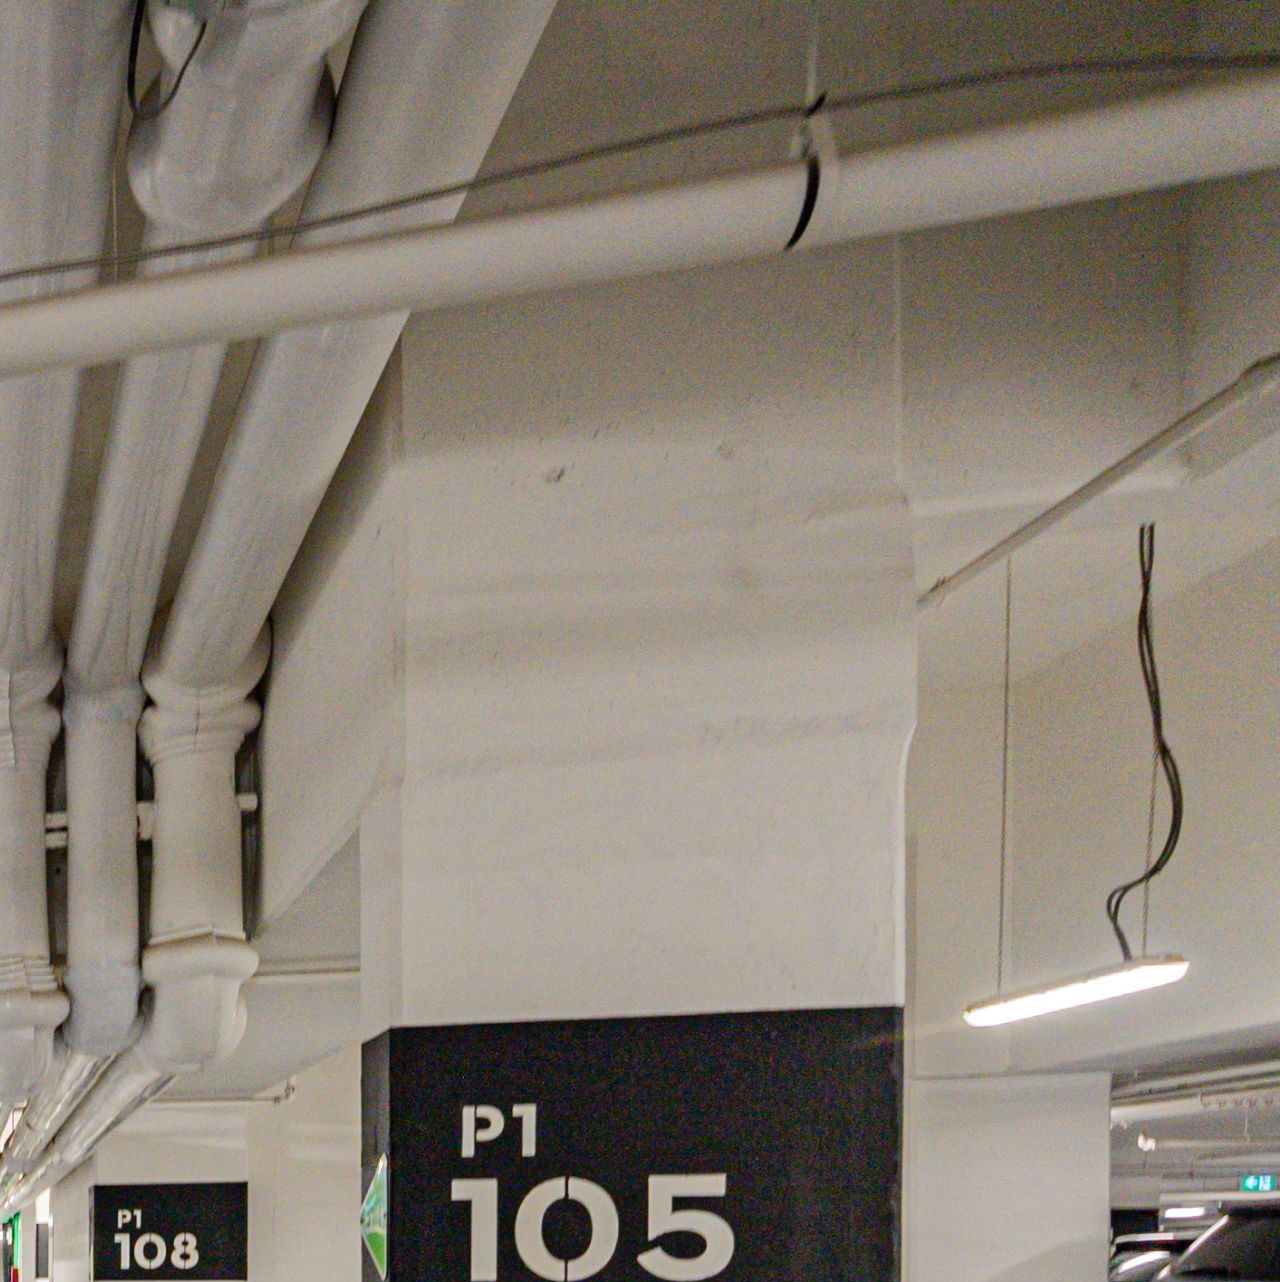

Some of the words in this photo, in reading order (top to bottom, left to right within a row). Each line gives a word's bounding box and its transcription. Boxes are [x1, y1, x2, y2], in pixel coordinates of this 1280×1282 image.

[461, 1103, 537, 1158] P1
[117, 1208, 142, 1230] P1
[451, 1173, 735, 1282] 105
[114, 1232, 200, 1270] 108
